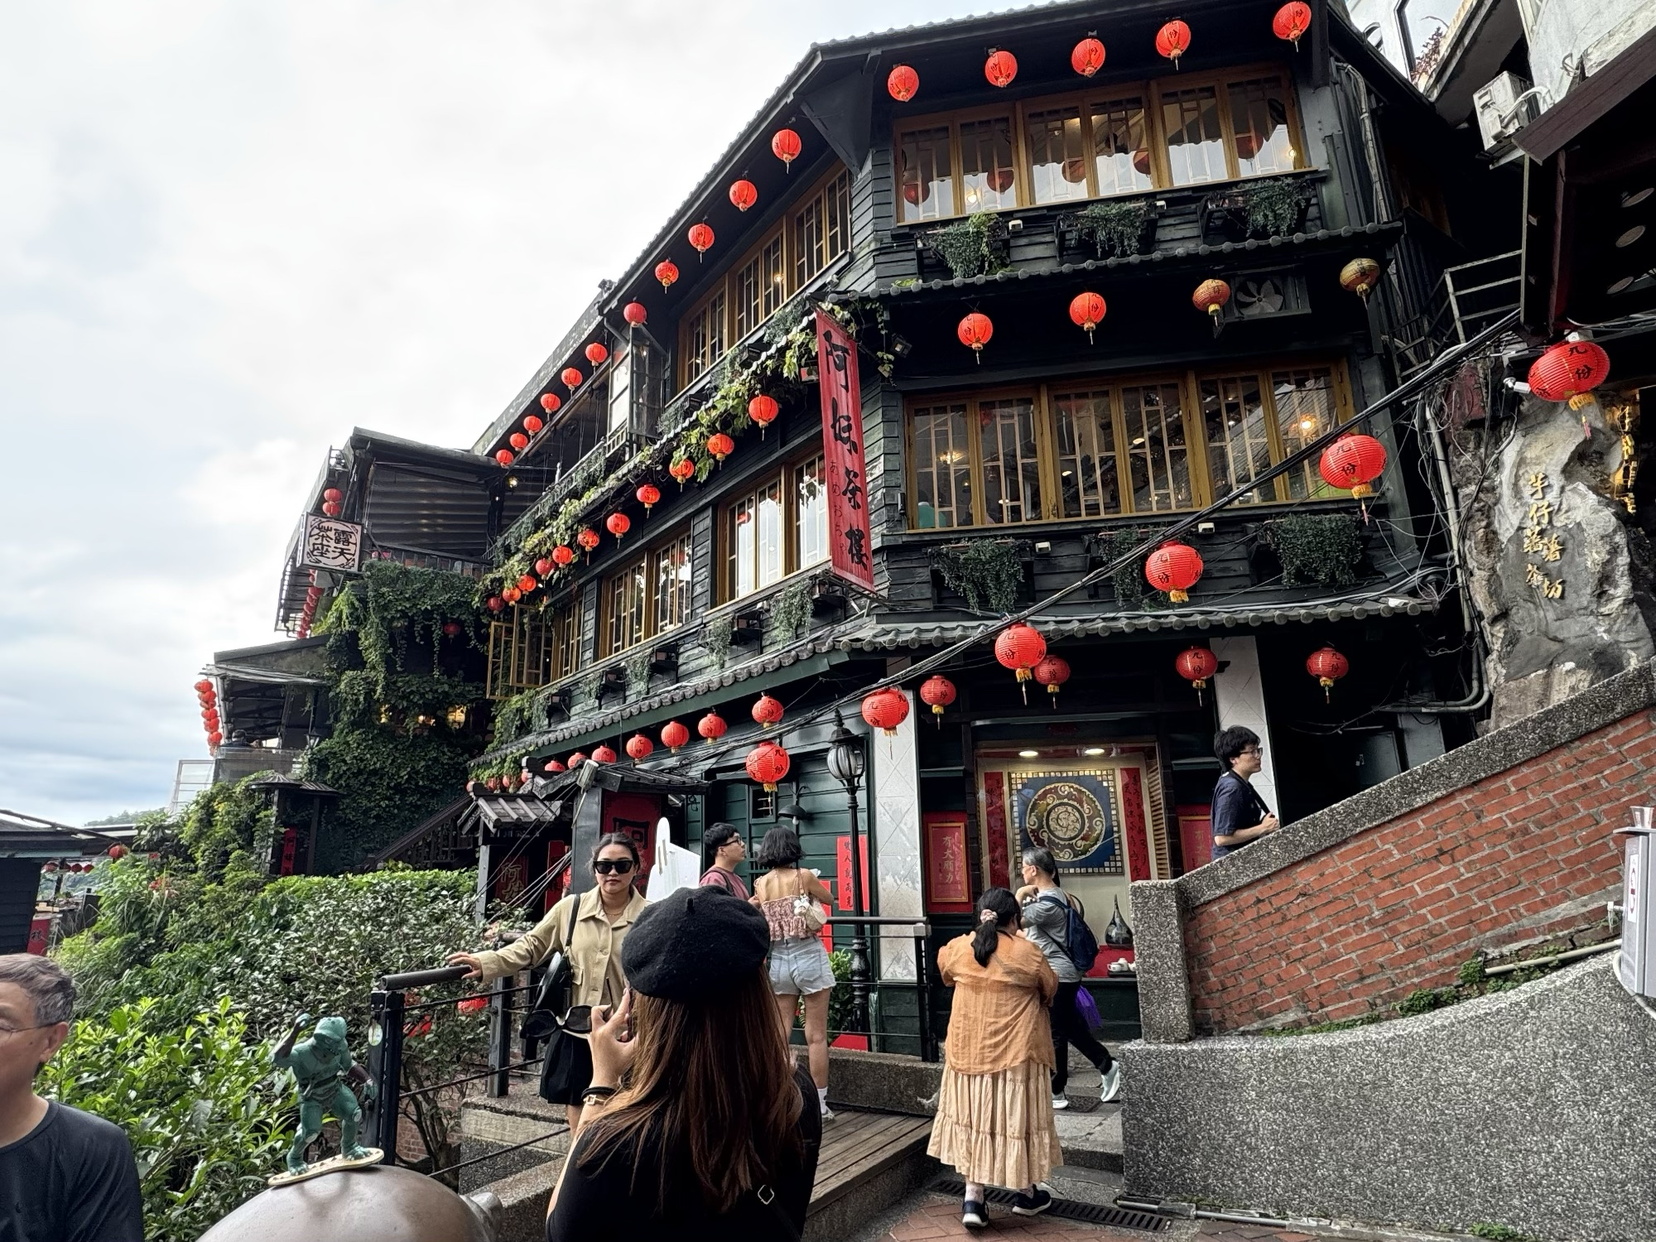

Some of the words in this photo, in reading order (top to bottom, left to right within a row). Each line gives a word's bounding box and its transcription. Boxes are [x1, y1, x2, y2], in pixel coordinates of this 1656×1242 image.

[1568, 345, 1594, 380] 九份
[1336, 443, 1357, 476] 九份
[1157, 552, 1170, 584] 九份
[1193, 652, 1204, 675] 九份
[868, 701, 881, 727] 九份
[775, 749, 786, 775] 九份
